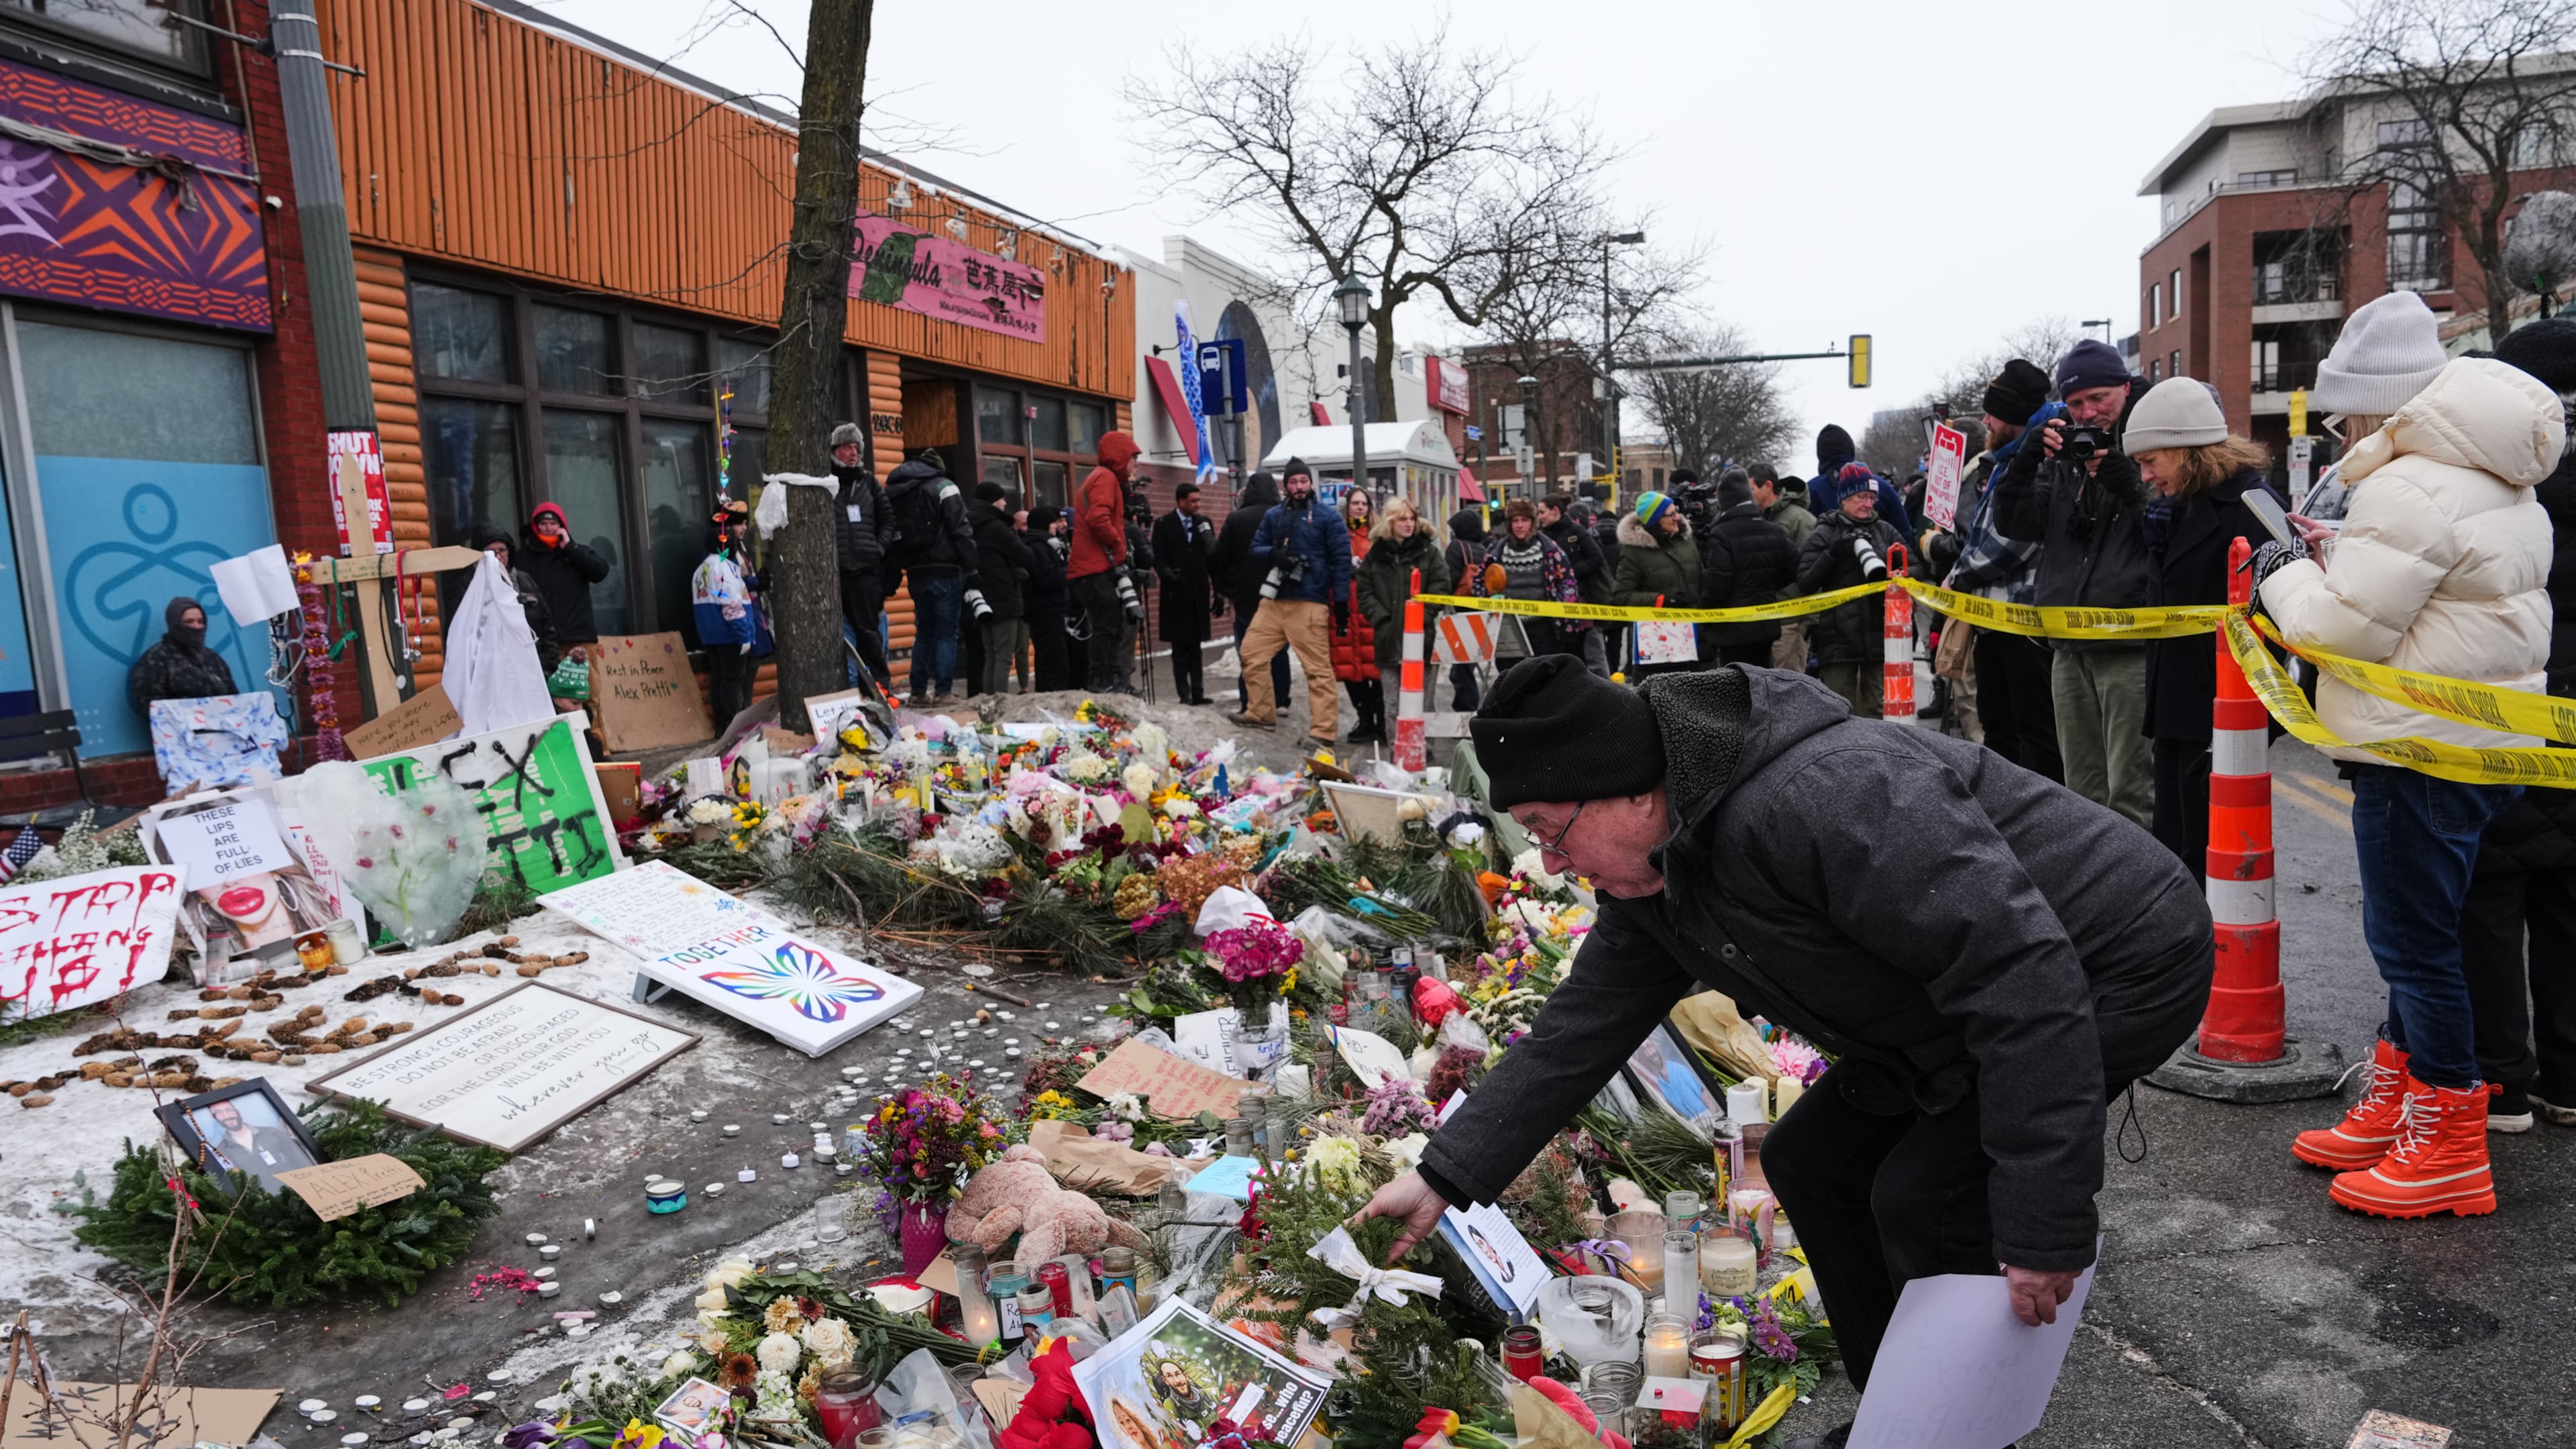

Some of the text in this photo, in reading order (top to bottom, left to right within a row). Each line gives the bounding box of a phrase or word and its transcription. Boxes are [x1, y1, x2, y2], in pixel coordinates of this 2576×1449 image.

[327, 432, 371, 454] SHUT
[1934, 476, 1951, 490] OUT OF
[606, 659, 665, 677] Rest in Peace
[614, 680, 671, 700] Alex Pretti
[815, 706, 835, 718] Let
[386, 716, 401, 730] you
[421, 726, 433, 737] my
[435, 710, 458, 727] LORD
[377, 731, 397, 746] when
[193, 806, 236, 823] THESE
[206, 821, 235, 835] LIPS
[215, 833, 240, 847] ARE
[216, 846, 250, 860] FULL
[215, 855, 262, 874] OF LIES
[658, 926, 775, 971] TOGETHER
[474, 1008, 580, 1065] OR DISCOURAGED
[347, 1004, 523, 1089] BE STRONG & COURAGEOUS
[396, 1024, 518, 1084] DO NOT BE AFRAID
[1258, 1044, 1273, 1055] Rest
[498, 1026, 610, 1089] WILL BE WITH YOU
[419, 1027, 579, 1111] FOR THE LORD YOUR GOD
[498, 1070, 585, 1122] wherever
[592, 1047, 626, 1075] you
[631, 1030, 660, 1053] go
[309, 1171, 368, 1200] ALEX
